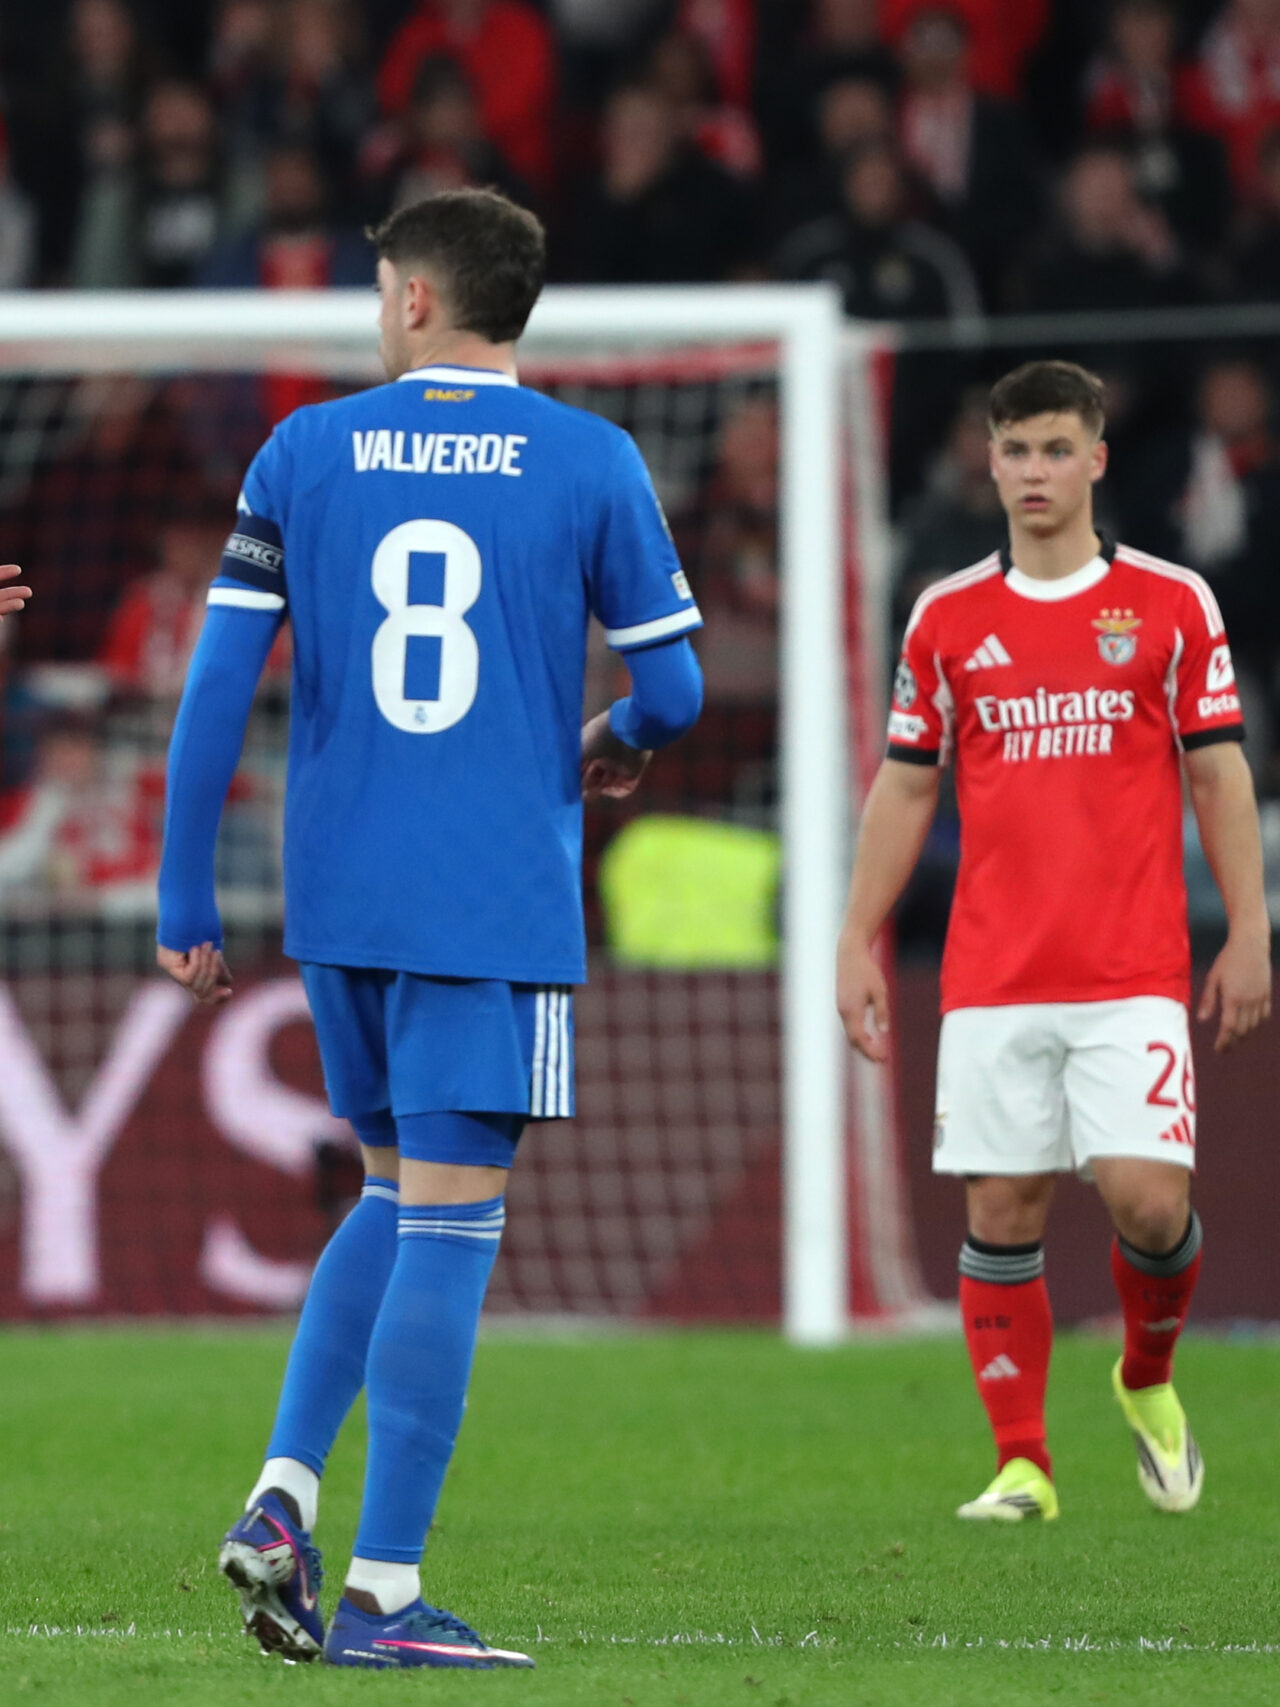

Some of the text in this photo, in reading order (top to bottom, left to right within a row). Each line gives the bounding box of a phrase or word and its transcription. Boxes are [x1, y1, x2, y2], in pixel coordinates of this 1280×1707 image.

[353, 429, 528, 477] VALVERDE
[371, 518, 482, 734] 8
[974, 686, 1135, 732] Emirates
[1003, 723, 1114, 762] FLY BETTER
